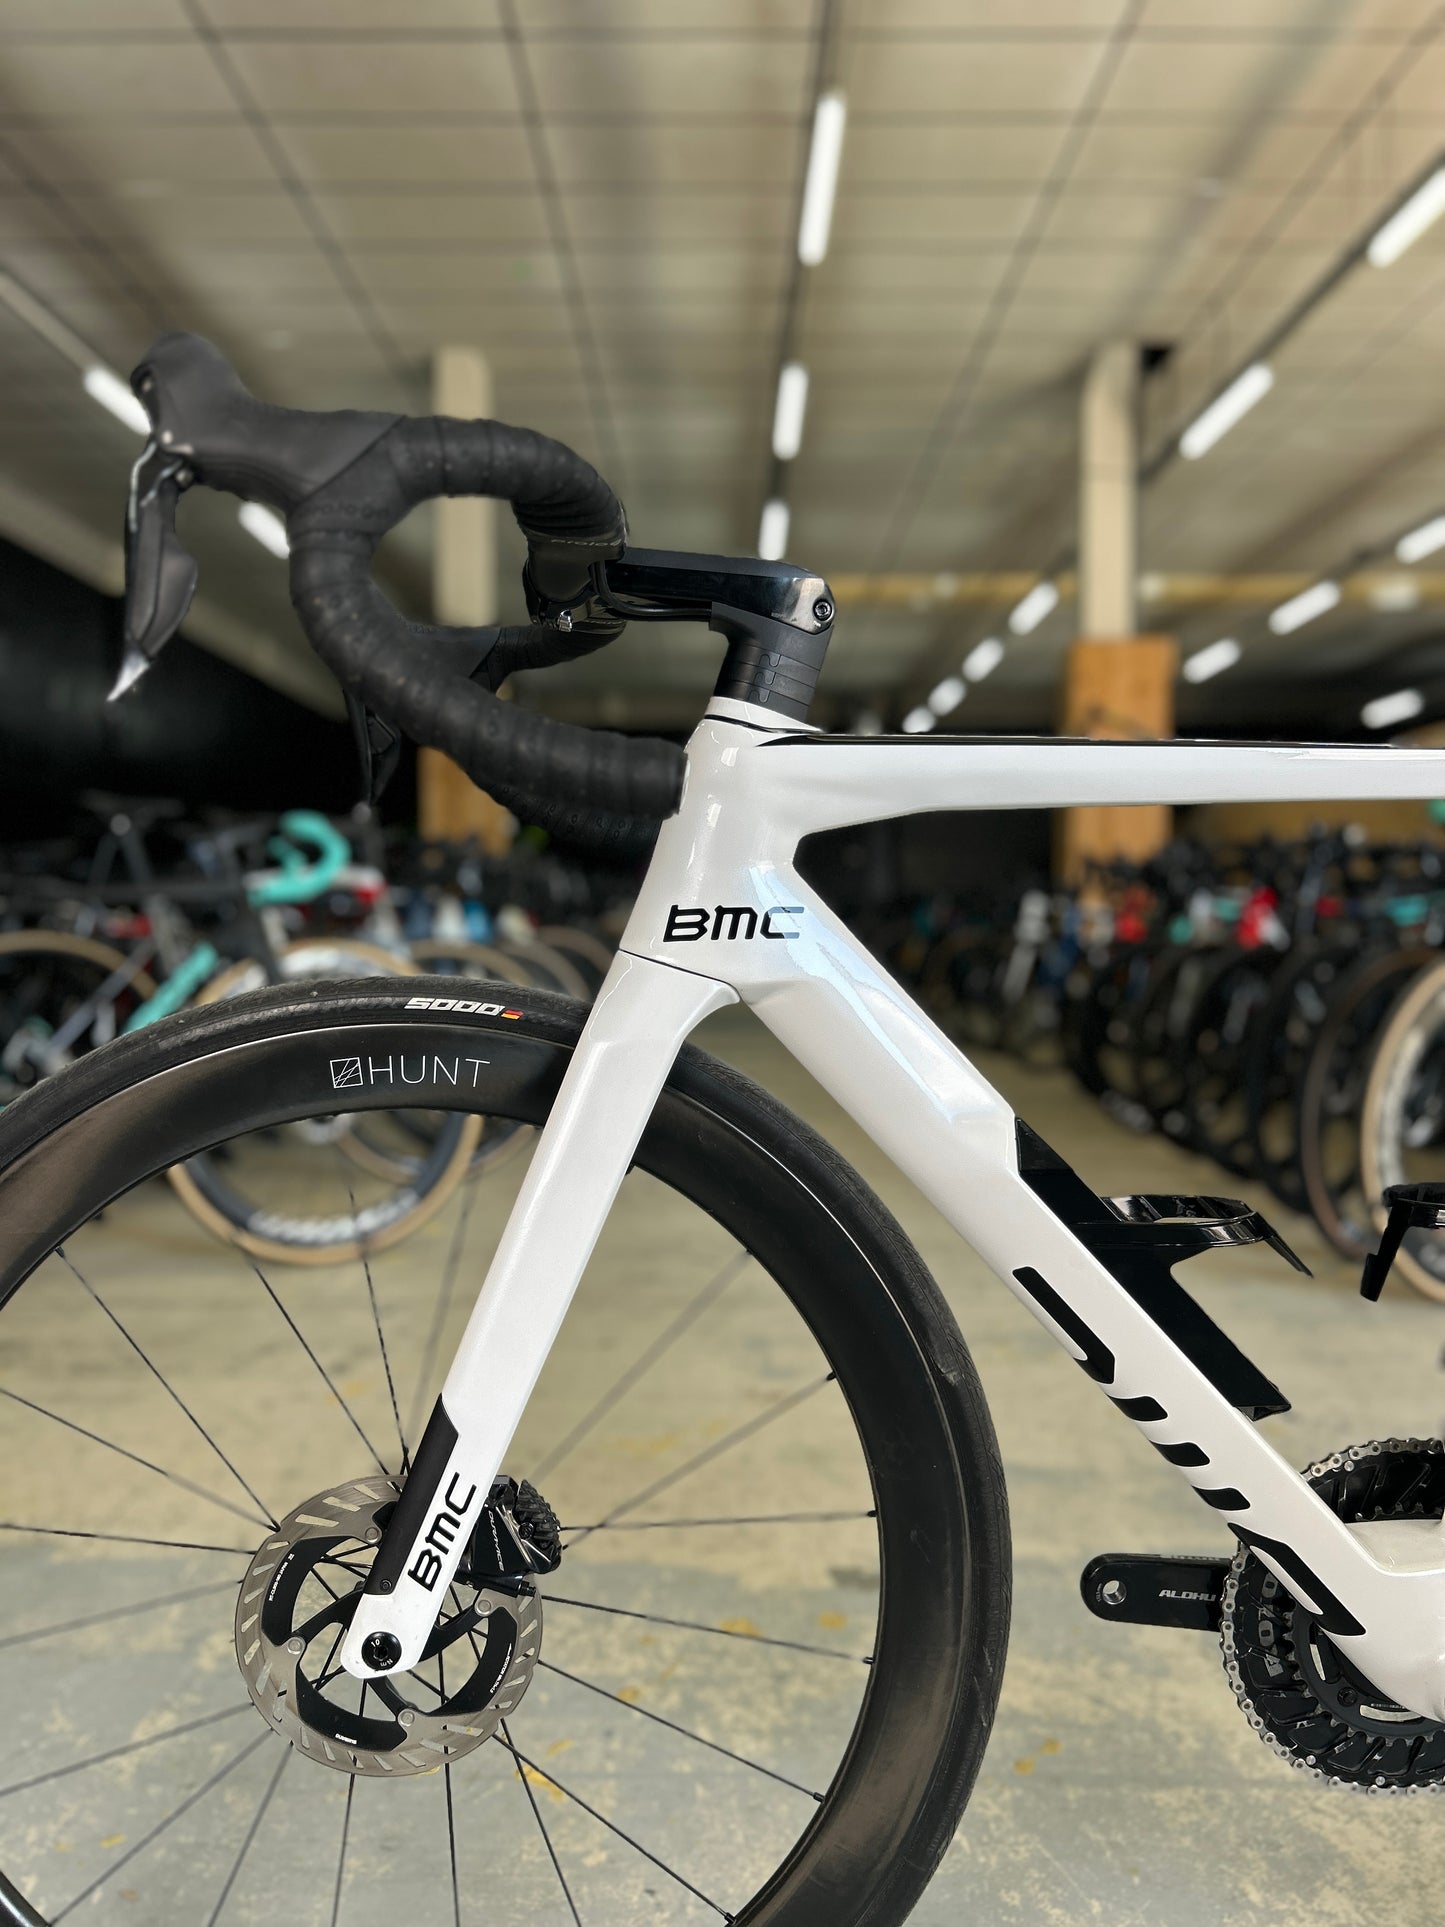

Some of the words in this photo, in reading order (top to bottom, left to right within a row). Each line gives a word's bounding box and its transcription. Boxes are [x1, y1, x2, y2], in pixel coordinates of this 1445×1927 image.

[663, 905, 804, 942] BMC
[404, 997, 505, 1017] 5000
[369, 1055, 490, 1088] HUNT
[408, 1472, 477, 1592] BMC
[1158, 1589, 1217, 1602] ALDHU
[370, 1638, 381, 1648] 10
